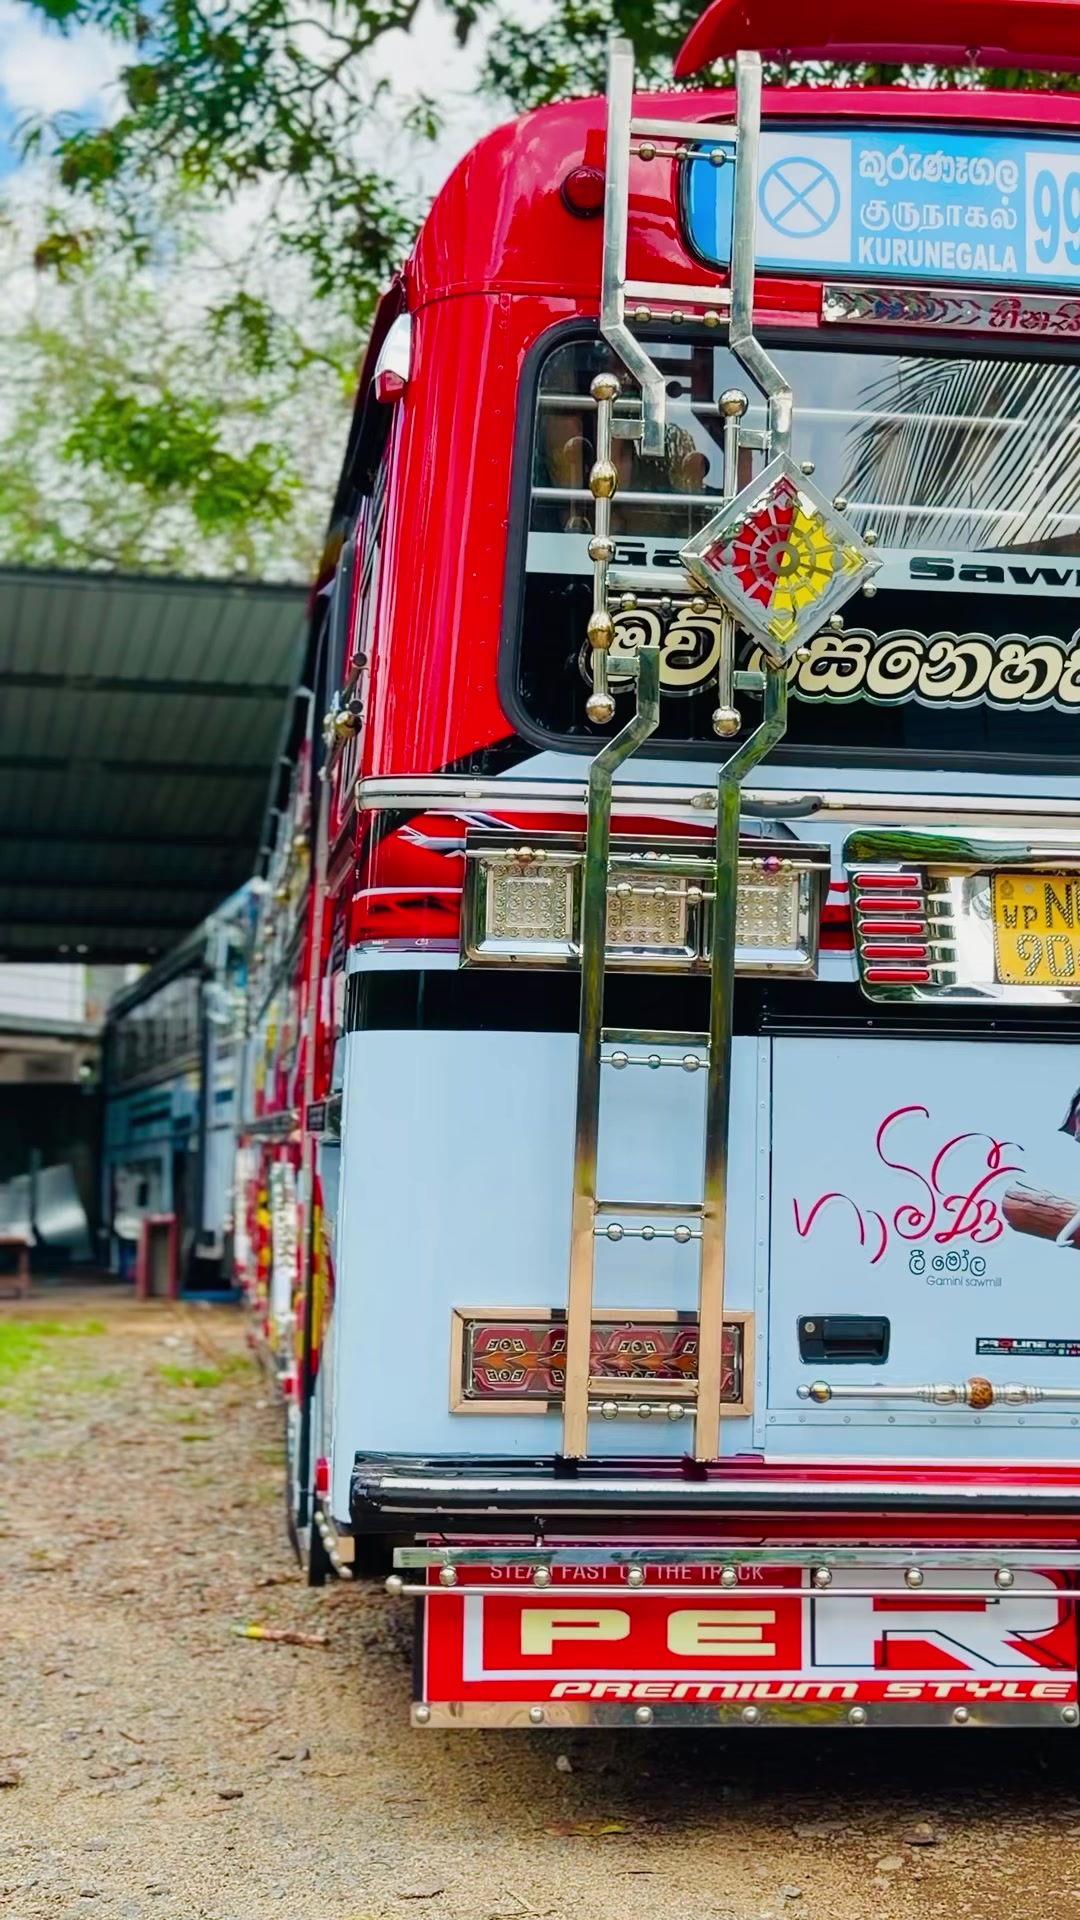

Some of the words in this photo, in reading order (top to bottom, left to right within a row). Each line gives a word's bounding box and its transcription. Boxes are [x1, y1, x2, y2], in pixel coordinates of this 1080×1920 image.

[859, 145, 1018, 193] කුරුණෑගල
[860, 196, 1017, 232] குருநாகல்
[858, 237, 1018, 272] KURUNEGALA
[1002, 904, 1038, 929] WP
[1044, 882, 1080, 928] N
[1016, 934, 1080, 976] 90
[926, 1275, 963, 1286] Gamini
[965, 1276, 1002, 1287] sawmill
[656, 1566, 692, 1580] THE
[549, 1681, 859, 1699] PREMIUM
[883, 1682, 1074, 1699] STYLE
